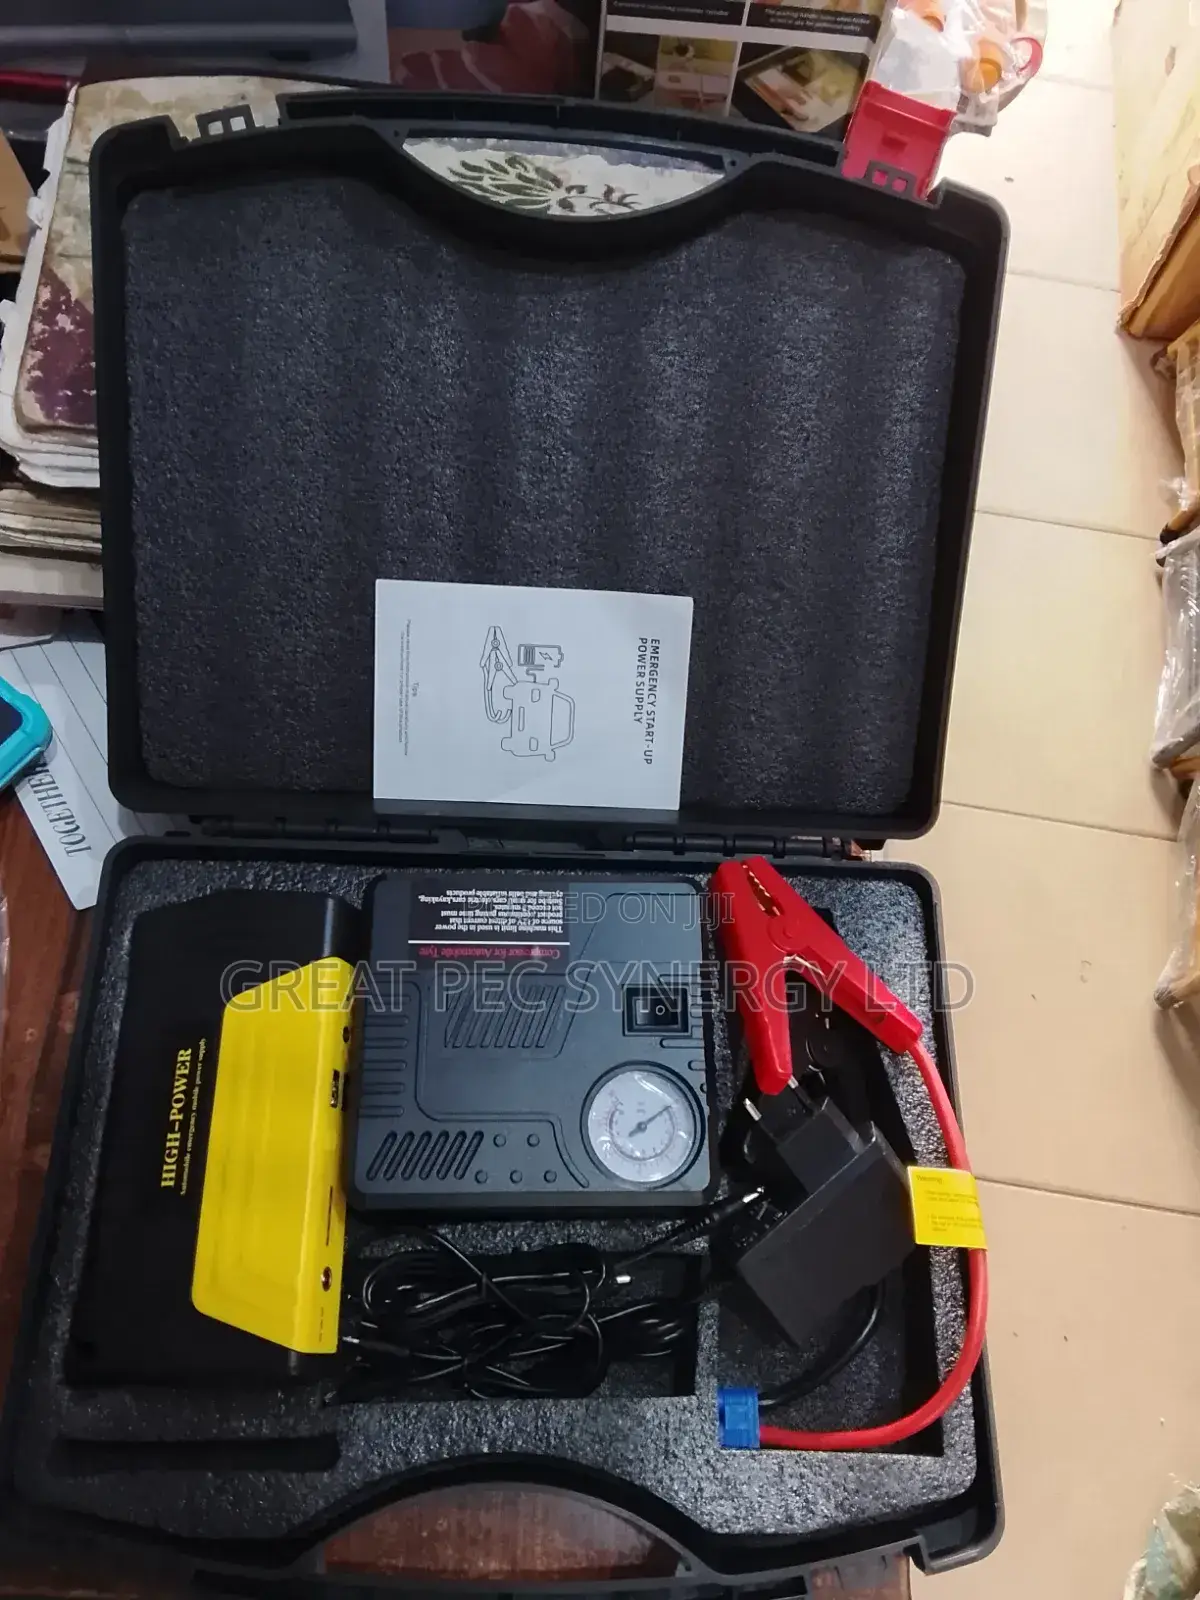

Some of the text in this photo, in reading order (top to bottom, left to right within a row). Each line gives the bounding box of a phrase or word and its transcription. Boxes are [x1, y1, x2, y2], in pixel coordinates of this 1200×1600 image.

[633, 637, 648, 724] POWER SUPPLY
[643, 638, 661, 765] EMERGENCY START-UP
[446, 889, 476, 897] products
[477, 925, 493, 933] used
[518, 925, 547, 933] machine
[548, 925, 564, 933] This
[419, 945, 439, 958] Tyre
[441, 947, 493, 958] Automobile
[494, 948, 507, 959] for
[194, 1063, 203, 1085] power
[191, 1086, 200, 1111] mobile
[161, 1048, 192, 1187] HIGH-POWER
[185, 1112, 197, 1151] emergency
[180, 1153, 191, 1196] Automobile
